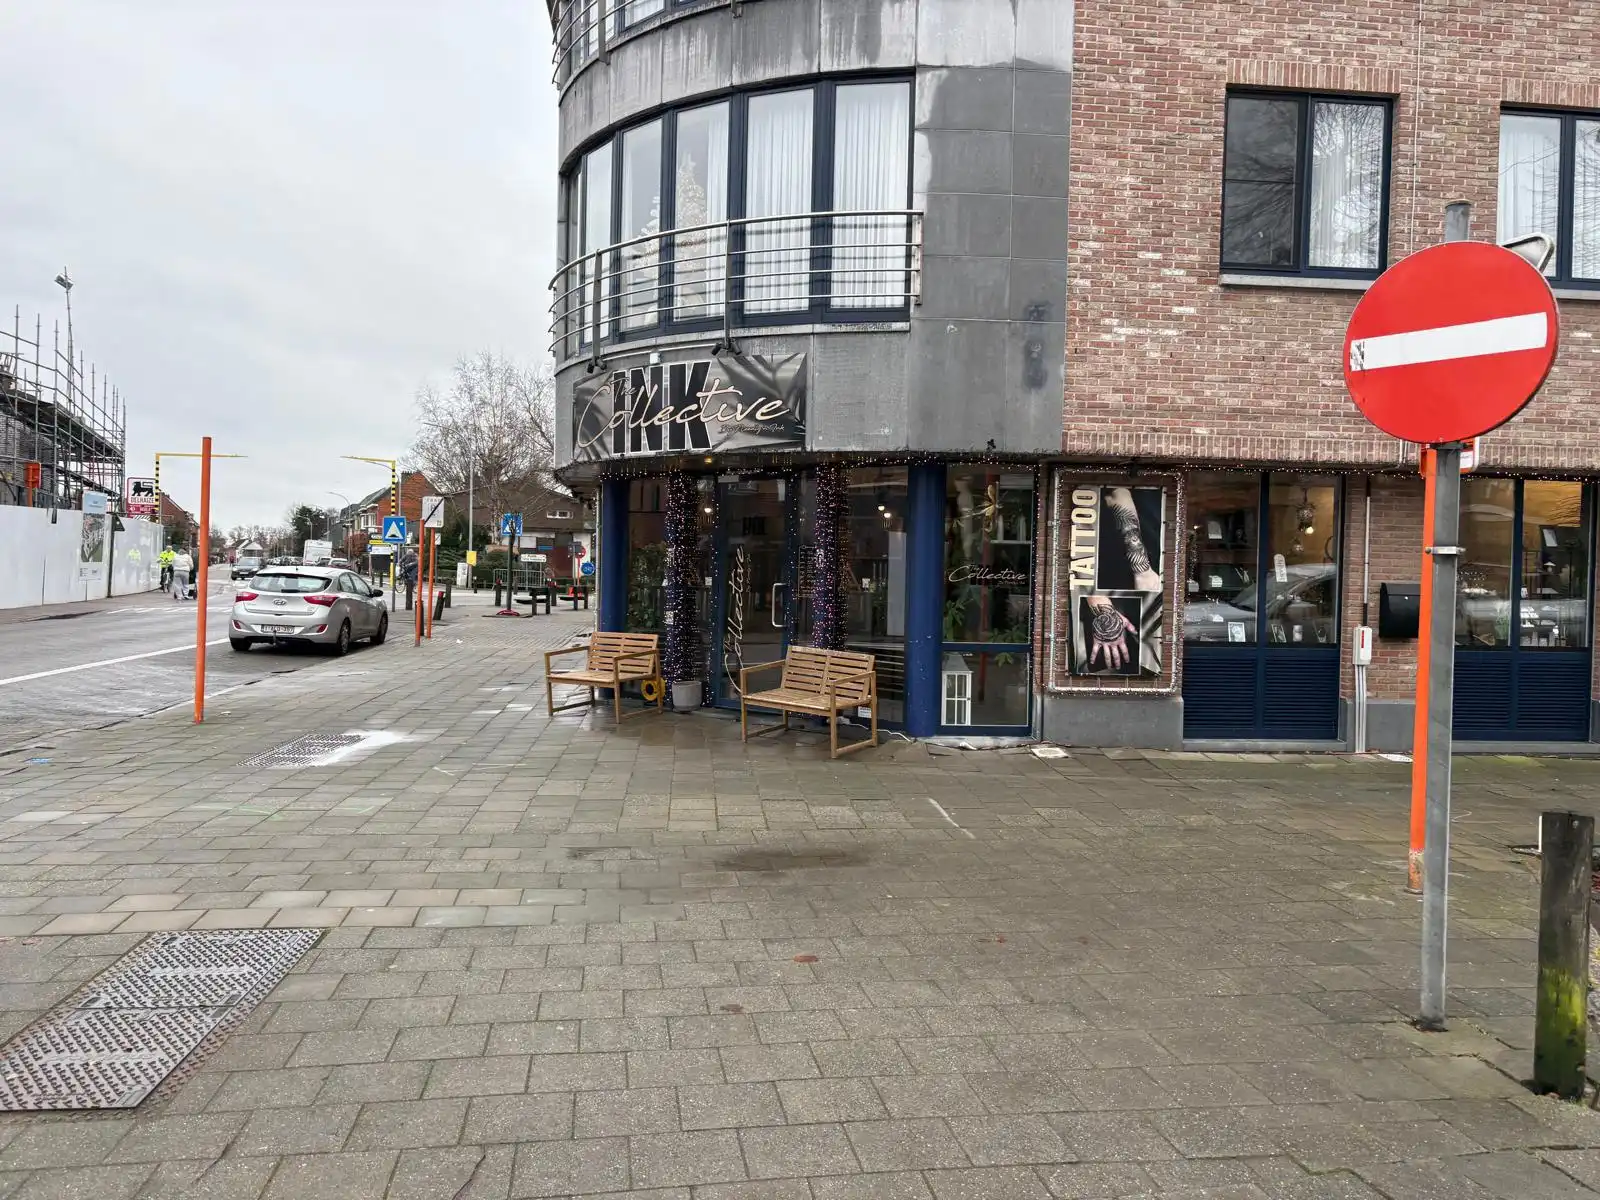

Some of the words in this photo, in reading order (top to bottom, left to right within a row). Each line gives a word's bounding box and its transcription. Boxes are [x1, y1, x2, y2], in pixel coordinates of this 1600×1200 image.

[577, 378, 790, 447] Collective
[610, 377, 637, 403] The
[612, 361, 712, 454] INK
[948, 564, 1028, 582] Collective
[1069, 489, 1097, 590] TATTOO
